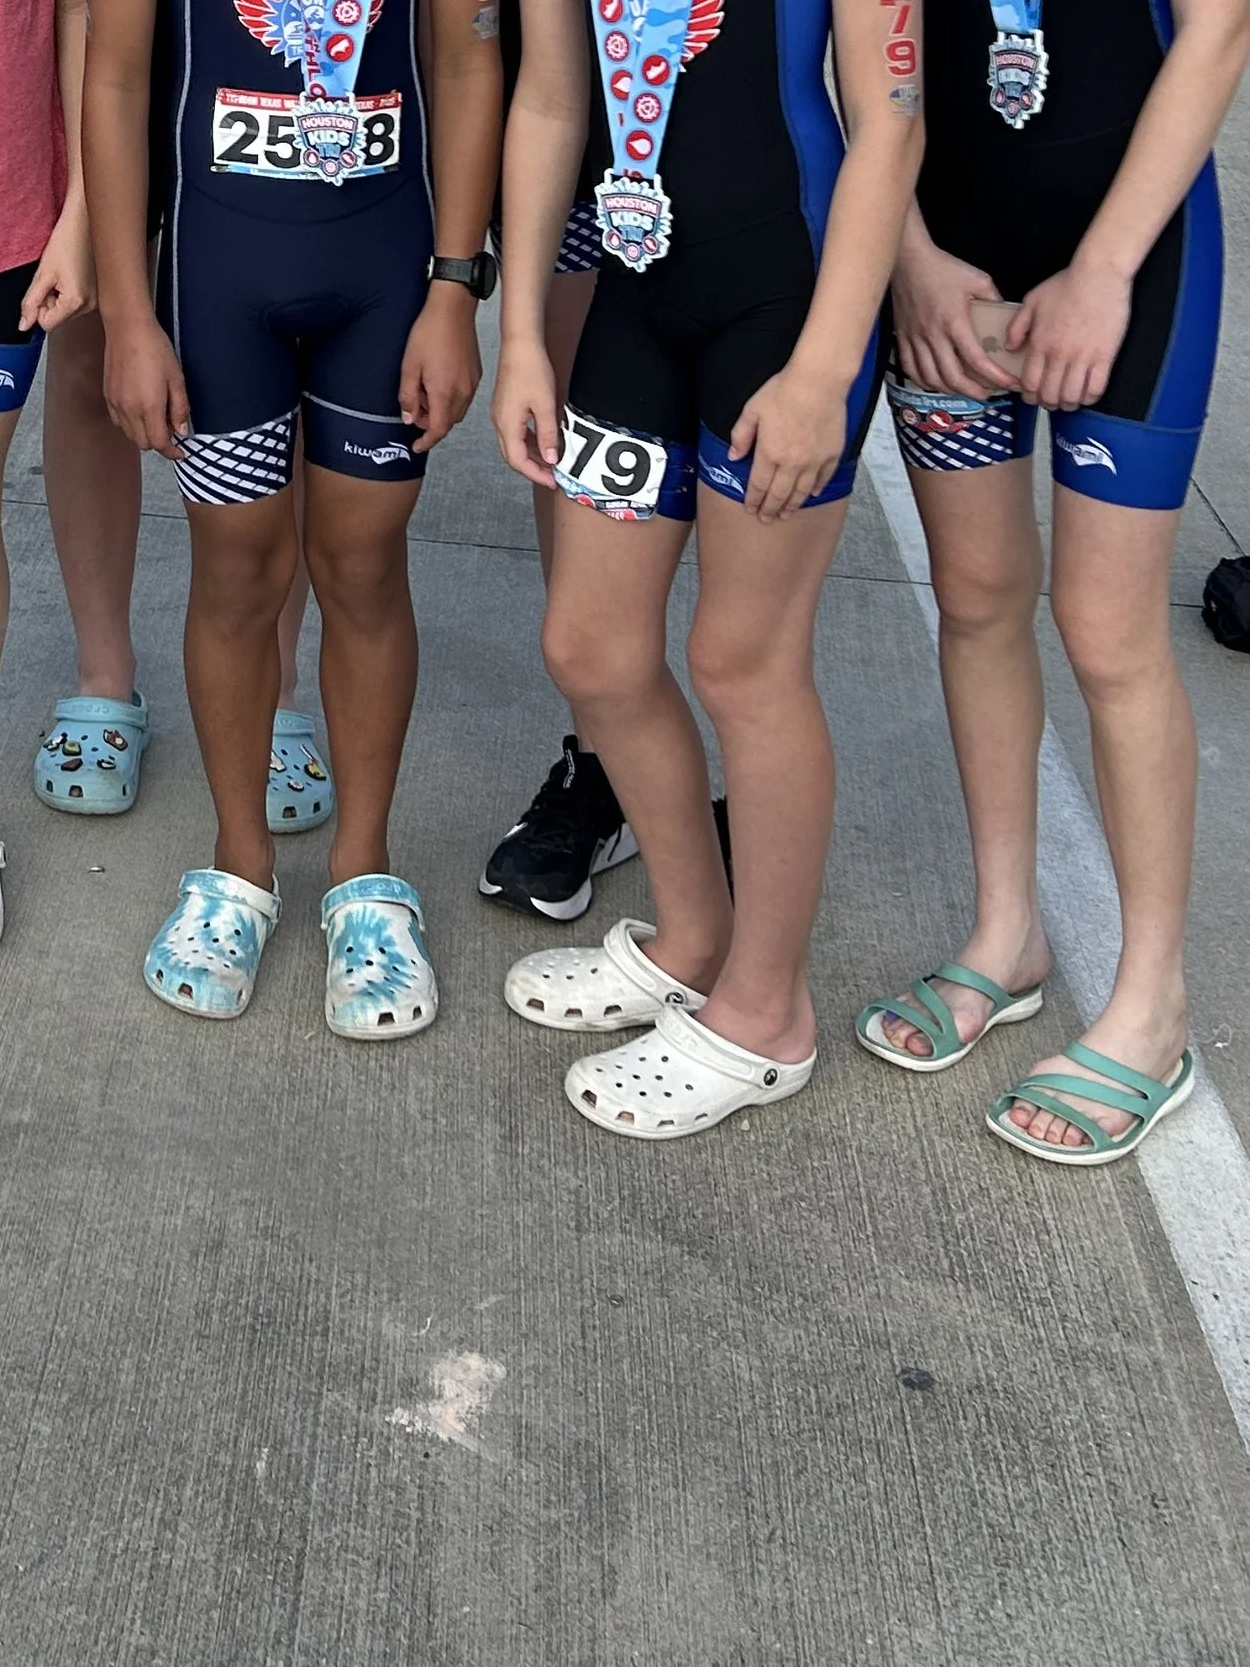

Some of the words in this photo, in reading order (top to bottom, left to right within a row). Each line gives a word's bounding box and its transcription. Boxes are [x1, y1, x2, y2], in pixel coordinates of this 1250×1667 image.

[302, 117, 354, 131] HOUSTON
[216, 111, 395, 169] 258
[308, 130, 350, 146] KIDS
[605, 197, 657, 214] HOUSTON
[610, 212, 654, 231] KIDS
